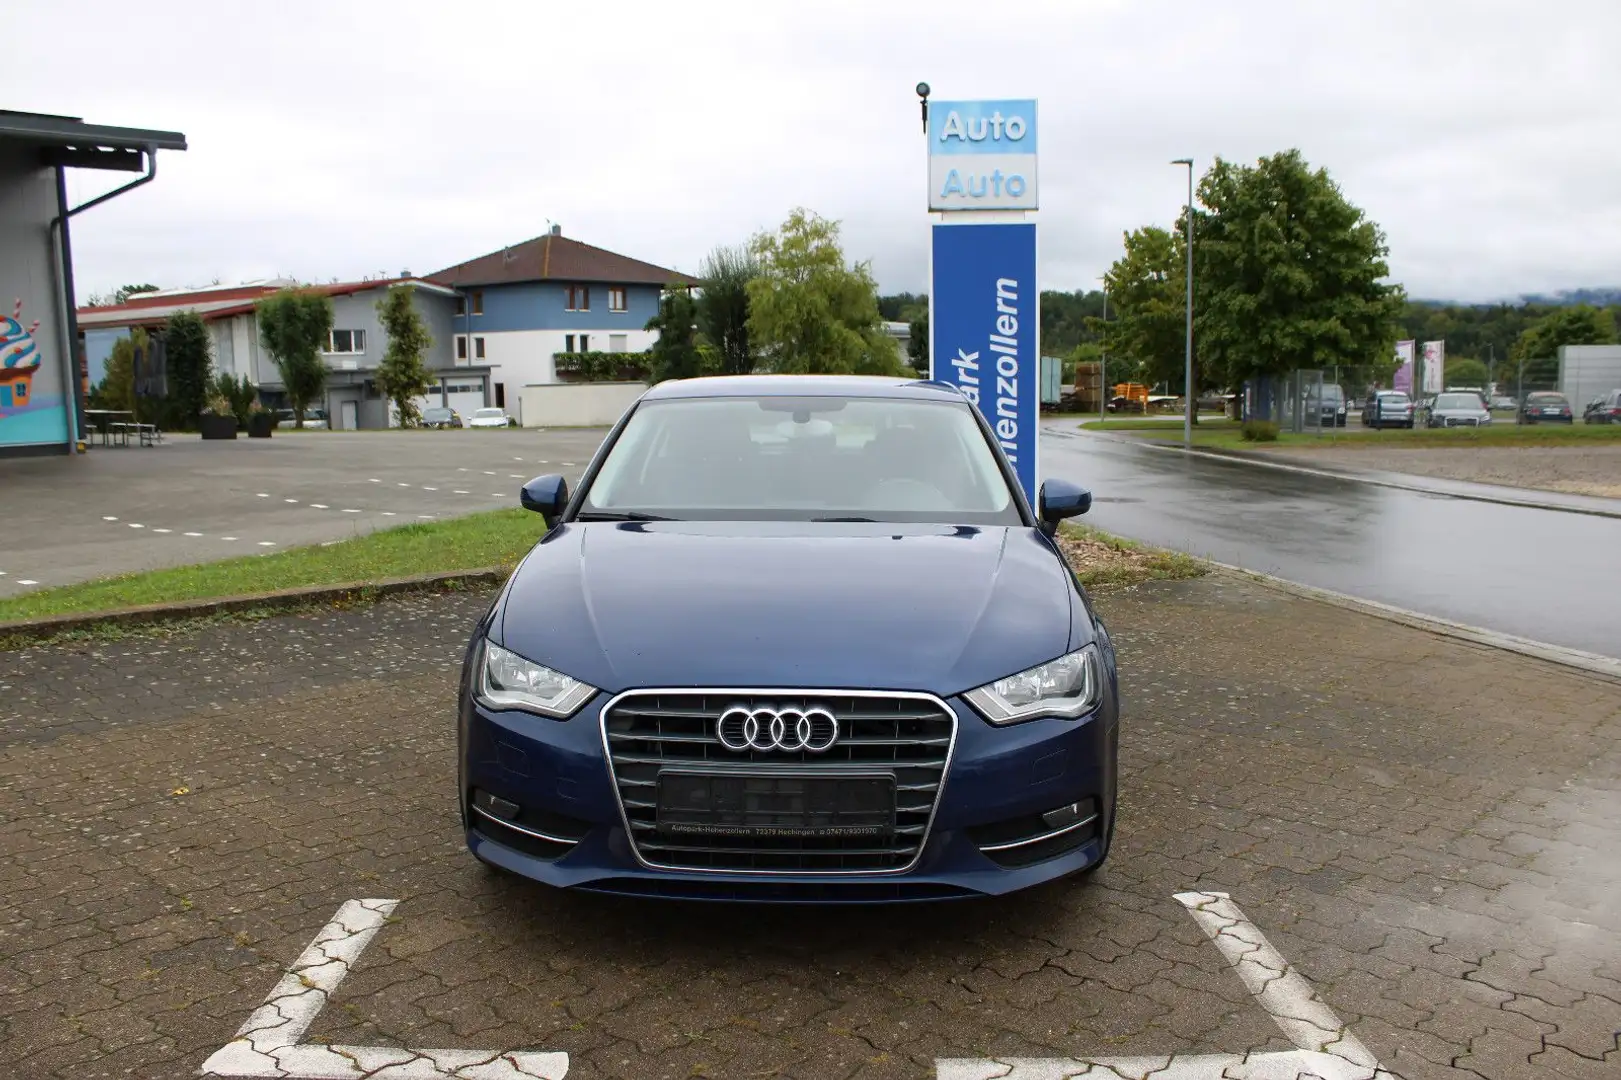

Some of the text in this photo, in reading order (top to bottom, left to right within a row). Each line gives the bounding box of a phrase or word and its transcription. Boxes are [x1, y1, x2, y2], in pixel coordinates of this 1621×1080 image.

[940, 110, 1026, 141] Auto
[940, 168, 1026, 198] Auto
[777, 827, 815, 837] Hechingen
